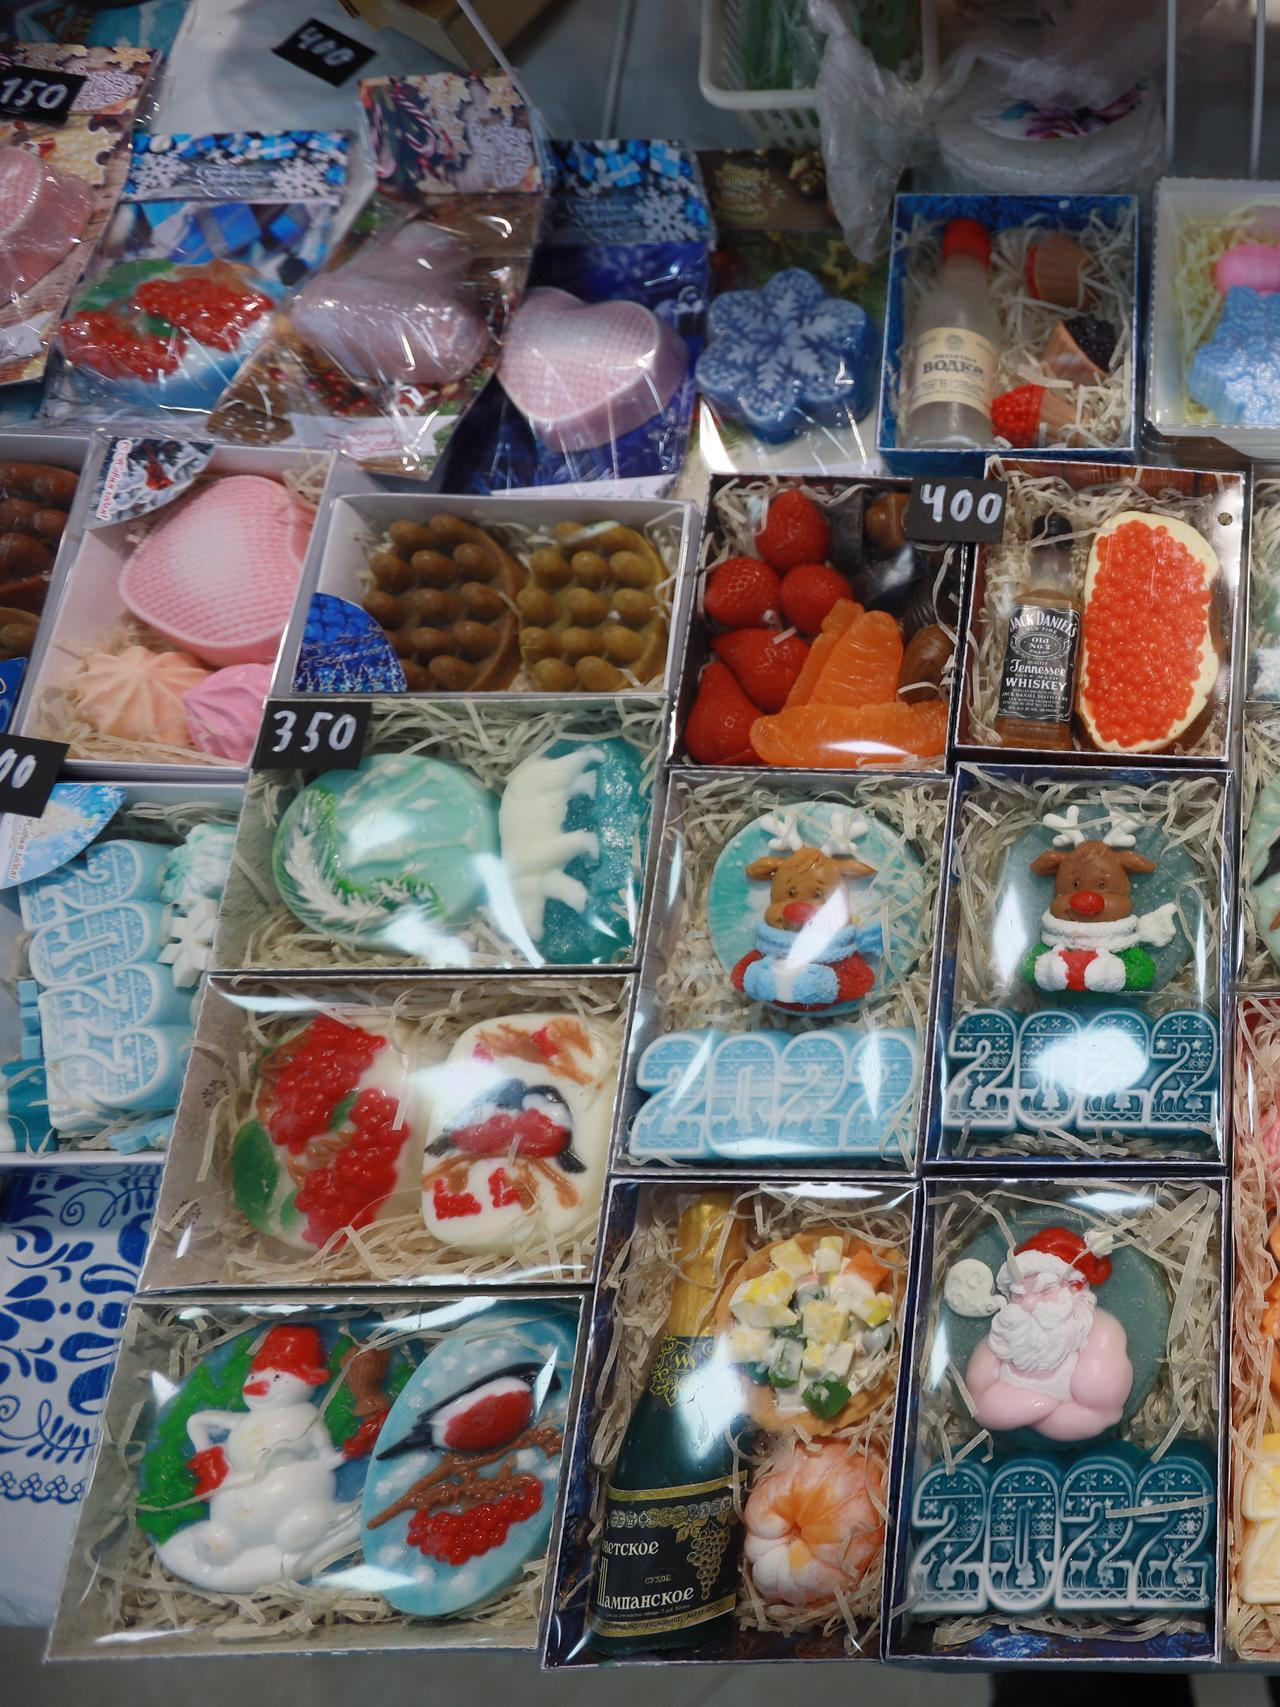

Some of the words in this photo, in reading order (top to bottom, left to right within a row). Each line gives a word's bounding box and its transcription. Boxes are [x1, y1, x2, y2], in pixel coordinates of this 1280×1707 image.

[920, 483, 1003, 524] 400
[1009, 612, 1034, 633] JACK
[1005, 677, 1068, 692] WHISKEY
[1009, 659, 1067, 677] Tennessee
[271, 709, 358, 753] 350
[628, 1030, 920, 1158] 2022
[911, 1462, 1214, 1613] 2022
